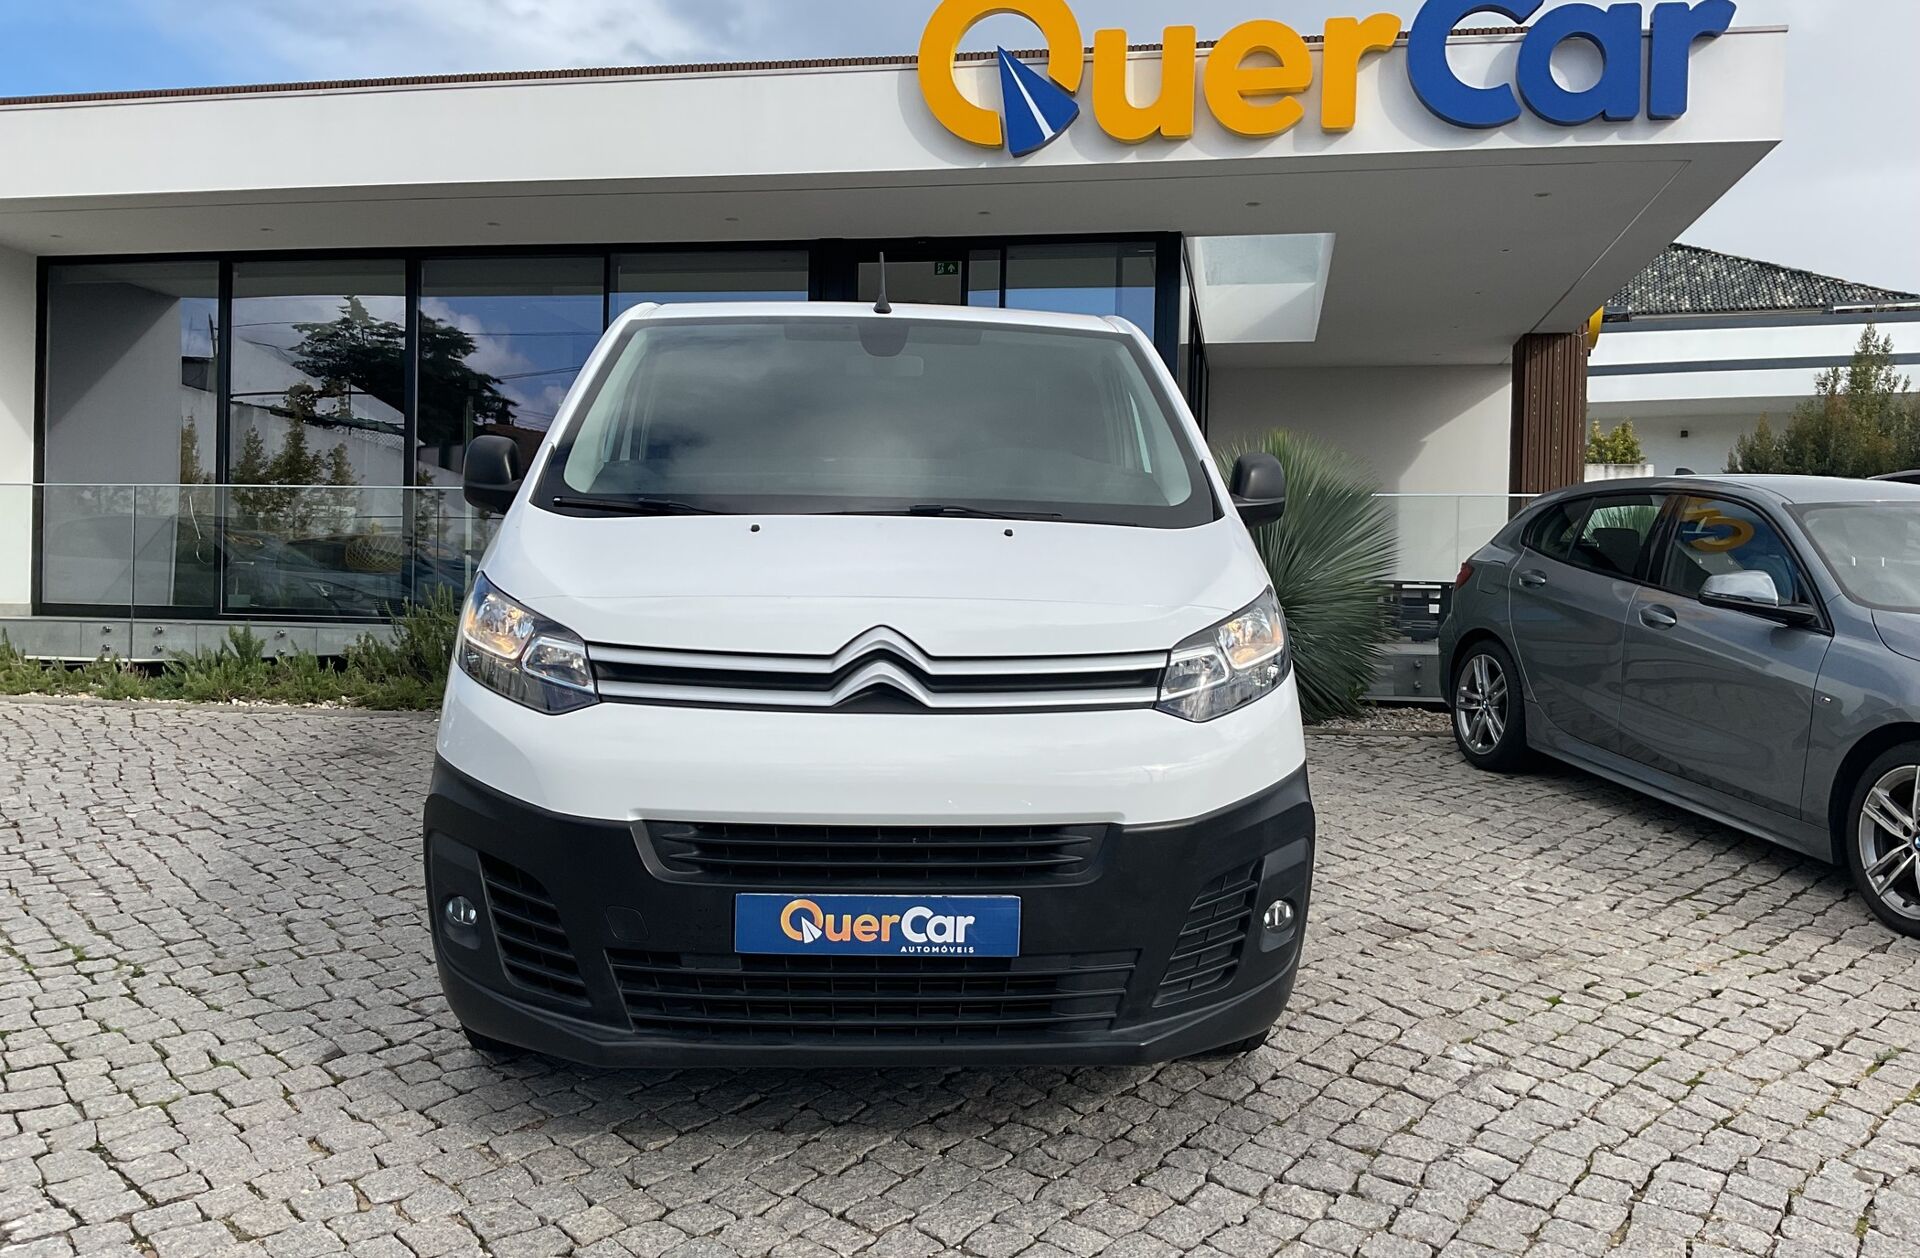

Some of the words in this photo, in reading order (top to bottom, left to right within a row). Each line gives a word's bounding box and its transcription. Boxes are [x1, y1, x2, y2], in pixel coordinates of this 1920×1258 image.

[918, 0, 1736, 157] QuerCar
[780, 899, 976, 943] QuerCar
[900, 945, 975, 954] AUTOMÓVEIS
